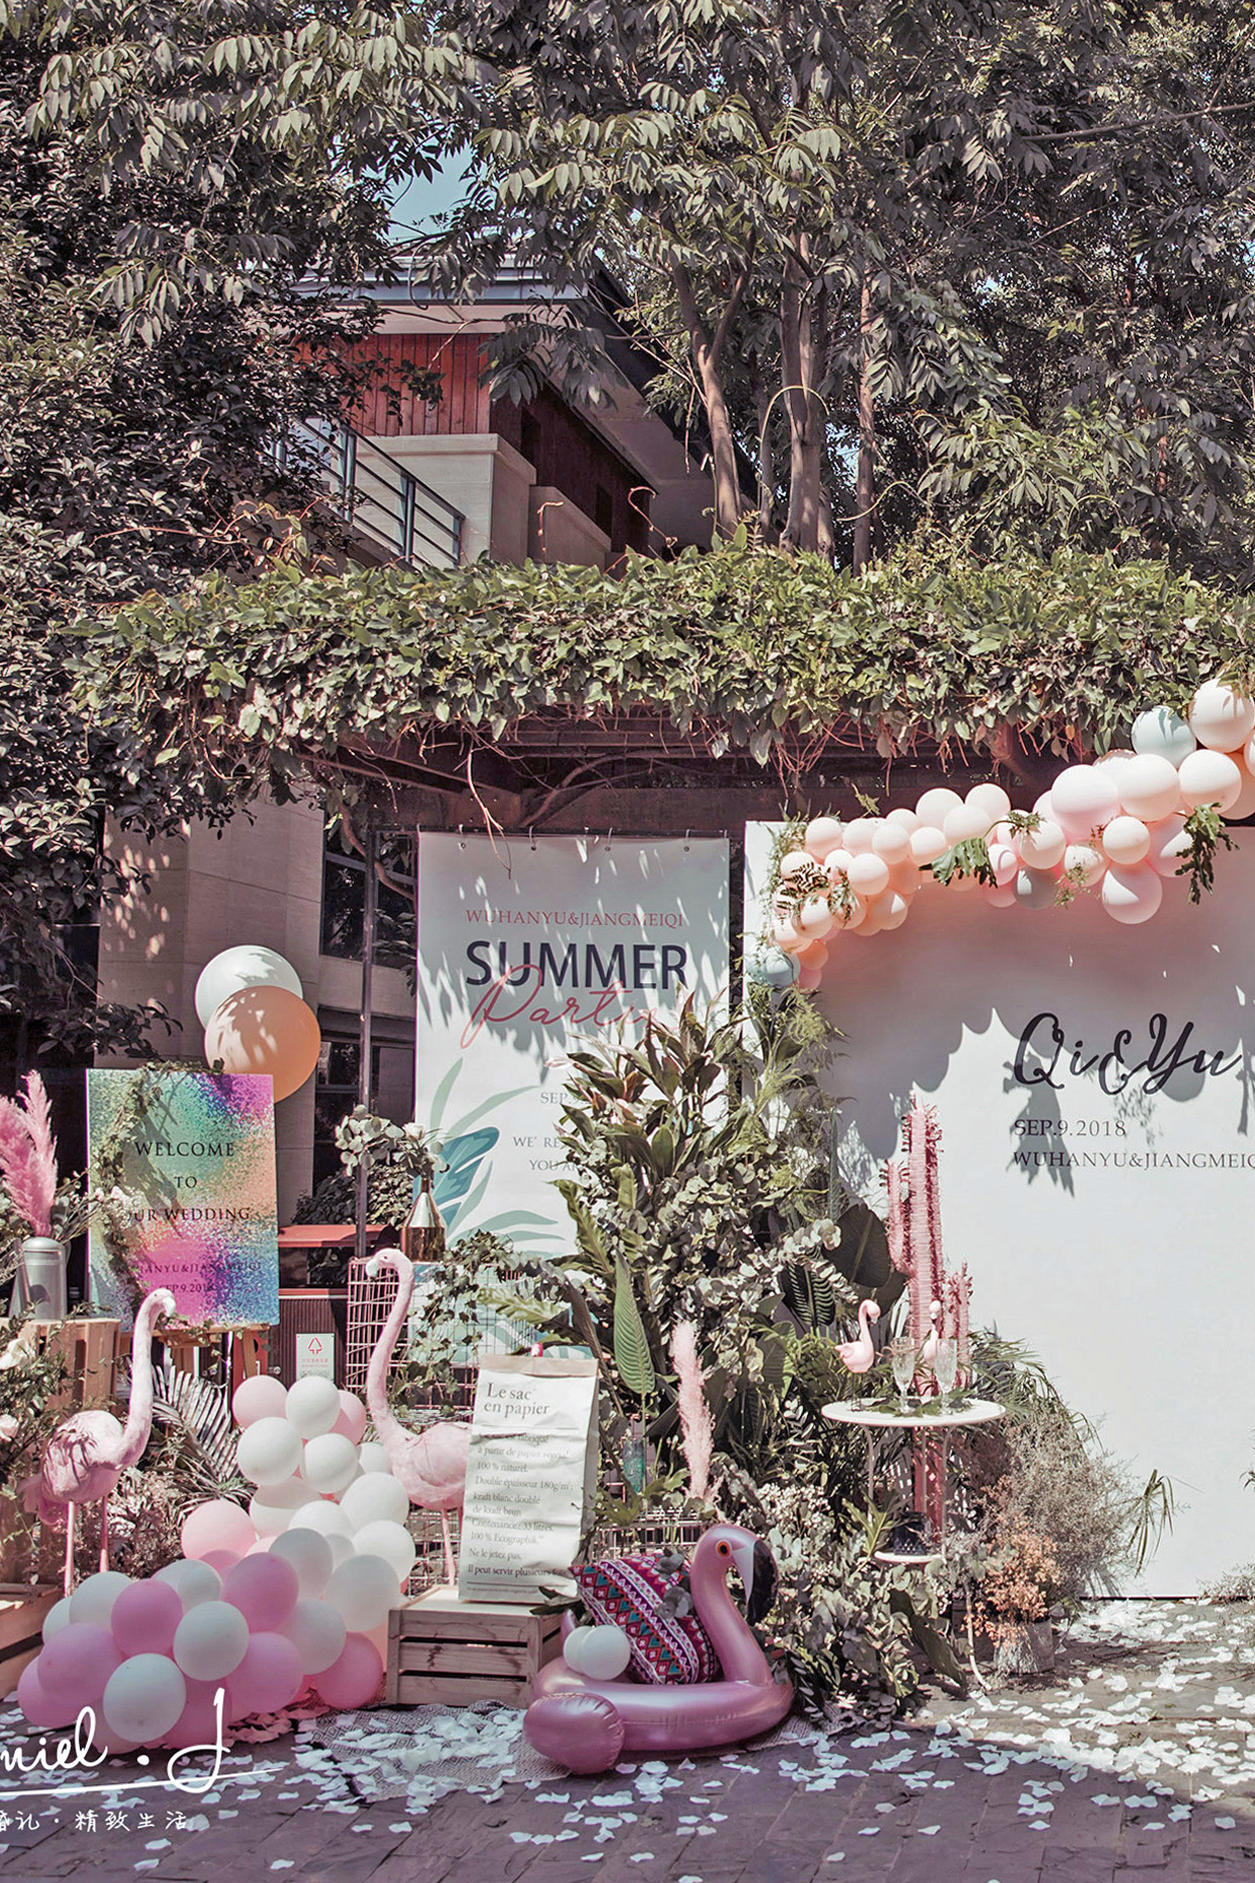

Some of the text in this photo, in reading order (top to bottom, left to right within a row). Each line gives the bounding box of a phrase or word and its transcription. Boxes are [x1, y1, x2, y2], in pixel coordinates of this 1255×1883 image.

[465, 909, 684, 929] WUHANYU&JIANGMEIQI
[466, 940, 688, 989] SUMMER
[1013, 1012, 1243, 1096] Qi&Yu
[1013, 1118, 1128, 1137] SEP.9.2018
[134, 1141, 235, 1157] WELCOME
[174, 1175, 198, 1189] TO
[164, 1207, 250, 1221] WEDDING
[488, 1382, 532, 1400] Le sac
[484, 1402, 550, 1420] en papier
